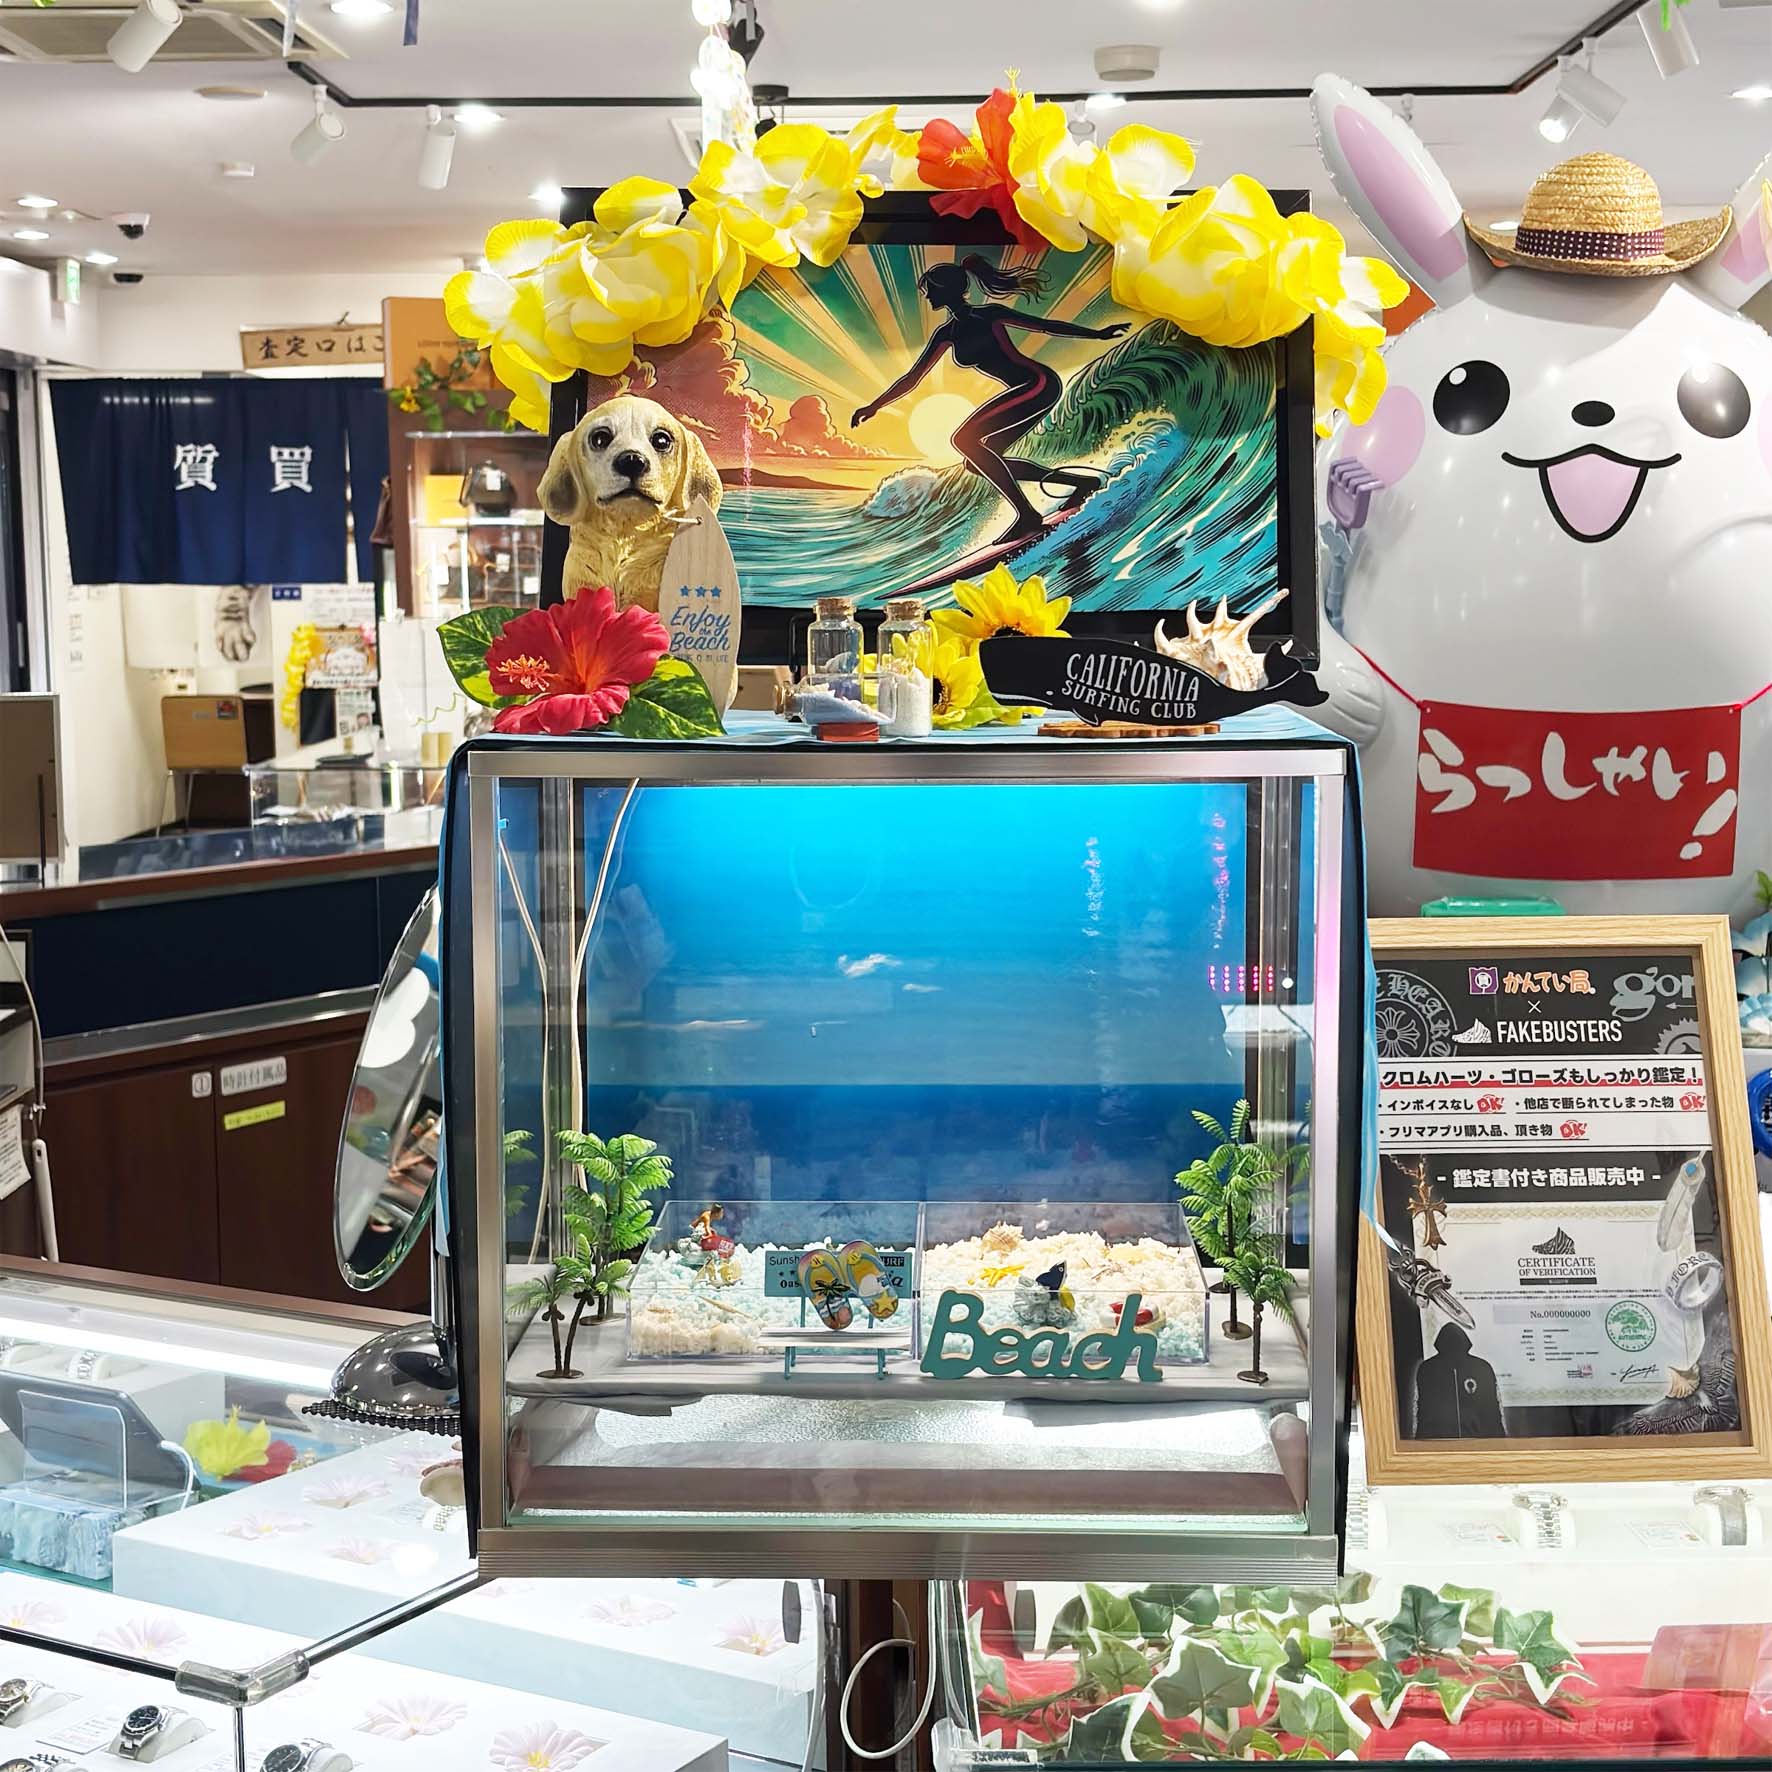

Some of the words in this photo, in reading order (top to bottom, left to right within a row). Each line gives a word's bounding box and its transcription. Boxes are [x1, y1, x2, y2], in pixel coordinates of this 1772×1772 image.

[174, 443, 220, 492] 質
[270, 445, 313, 493] 買
[670, 604, 731, 637] Enjoy
[669, 630, 731, 653] Beach
[1066, 653, 1200, 702] CALIFORNIA
[1061, 679, 1141, 716] SURFING
[1150, 702, 1197, 719] CLUB
[1496, 1019, 1623, 1043] FAKEBUSTERS
[1517, 1257, 1596, 1268] CERTIFICATE
[1518, 1268, 1531, 1277] OF
[1532, 1267, 1596, 1277] VERIFICATION
[920, 1288, 1163, 1382] Beach
